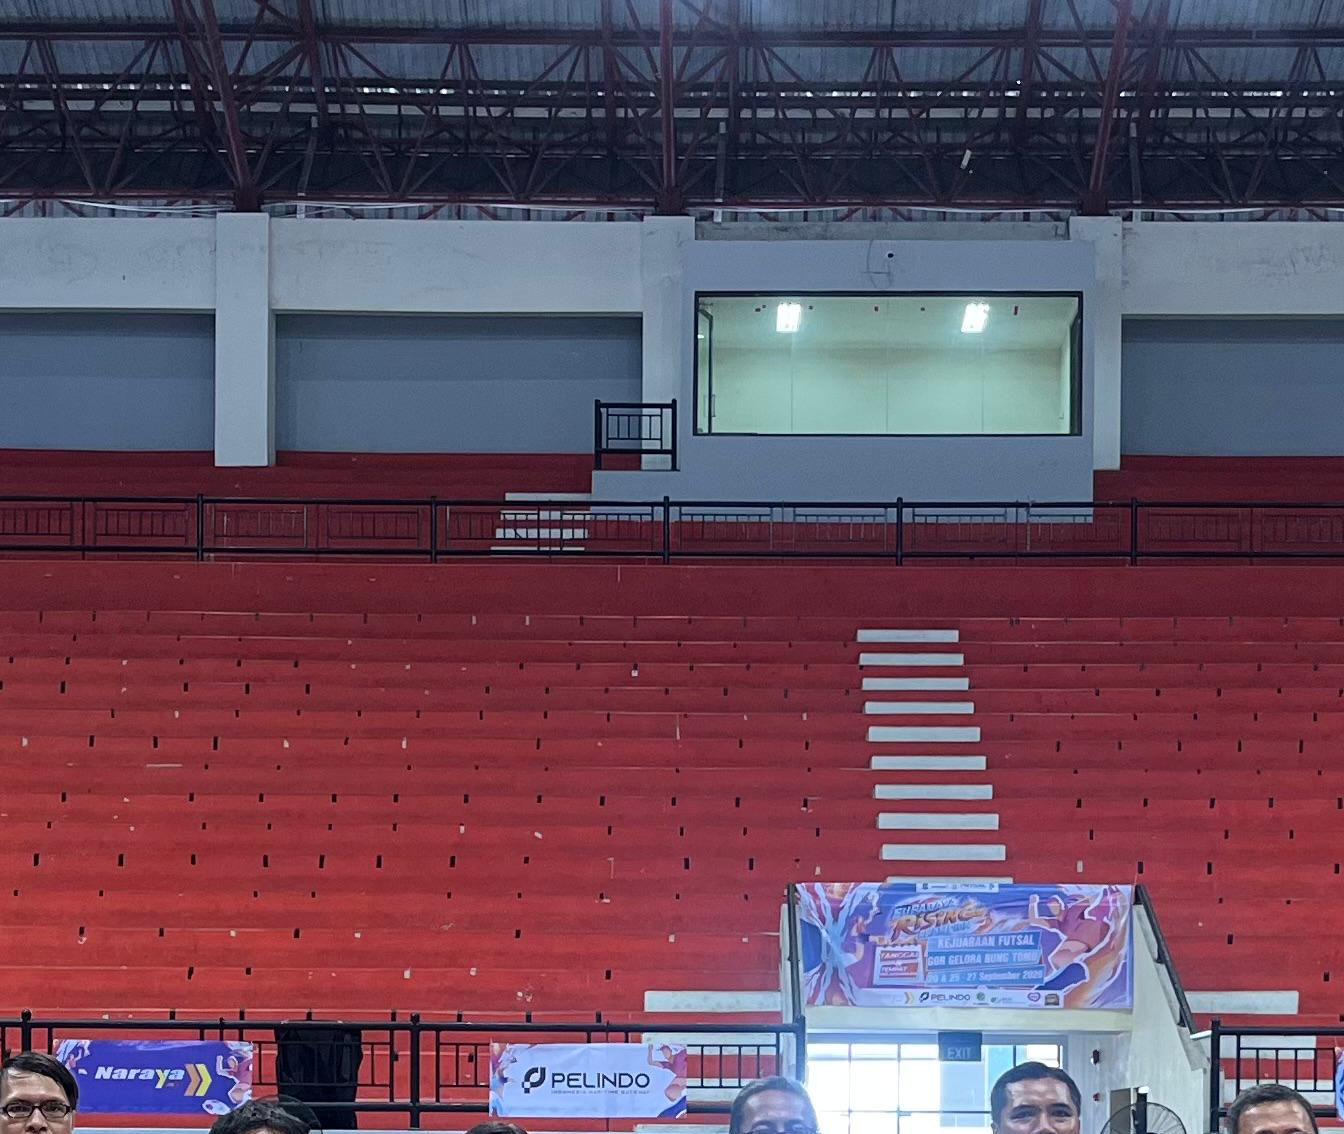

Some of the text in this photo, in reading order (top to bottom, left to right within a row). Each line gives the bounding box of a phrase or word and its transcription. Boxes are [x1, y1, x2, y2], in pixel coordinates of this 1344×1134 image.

[937, 934, 1035, 949] KEJUARAAN FUTSAL
[948, 953, 982, 965] GELORA
[930, 993, 971, 1001] PELINDO
[94, 1065, 185, 1089] Naraya
[551, 1072, 651, 1089] PELINDO
